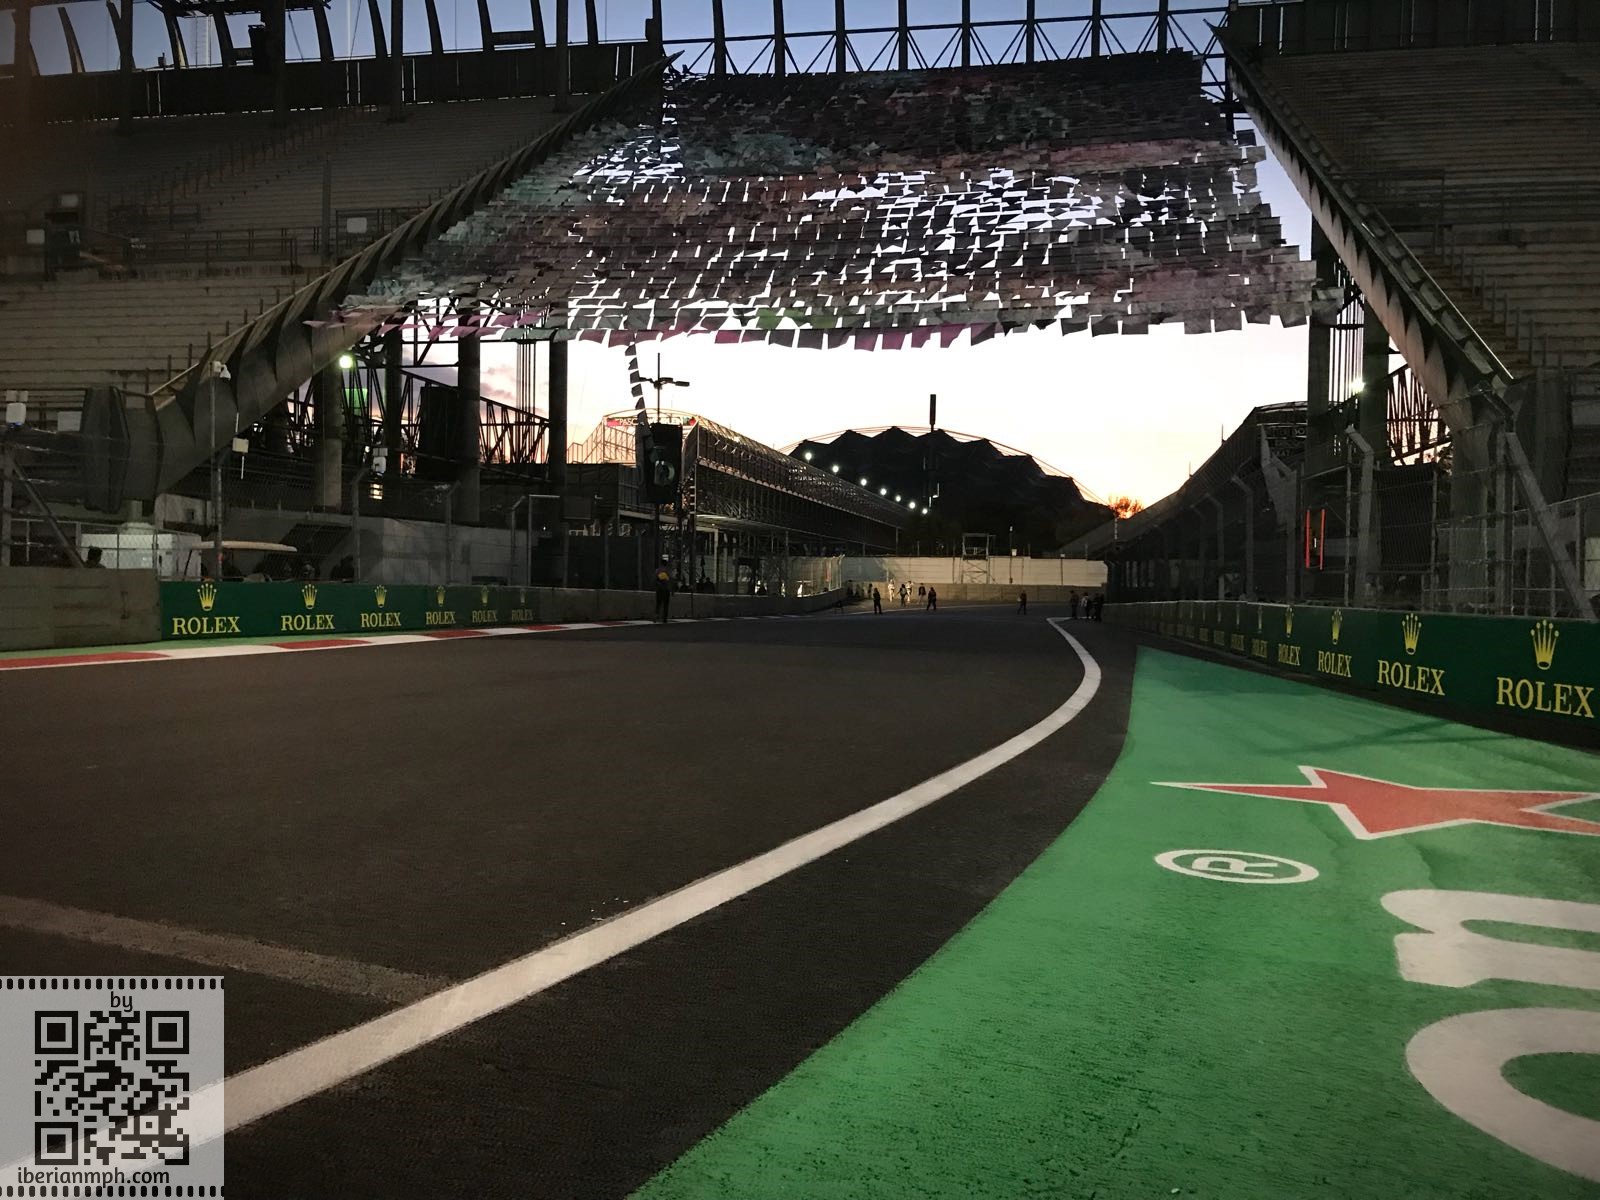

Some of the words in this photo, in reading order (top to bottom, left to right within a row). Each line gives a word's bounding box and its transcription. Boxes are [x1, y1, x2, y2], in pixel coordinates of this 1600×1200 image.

[171, 615, 242, 636] ROLEX
[280, 613, 336, 631] ROLEX
[360, 611, 402, 628] ROLEX
[425, 610, 457, 625] ROLEX
[471, 609, 498, 623] ROLEX
[1278, 643, 1301, 667] ROLEX
[1317, 650, 1352, 679] ROLEX
[1376, 659, 1447, 697] ROLEX
[1496, 676, 1596, 719] ROLEX
